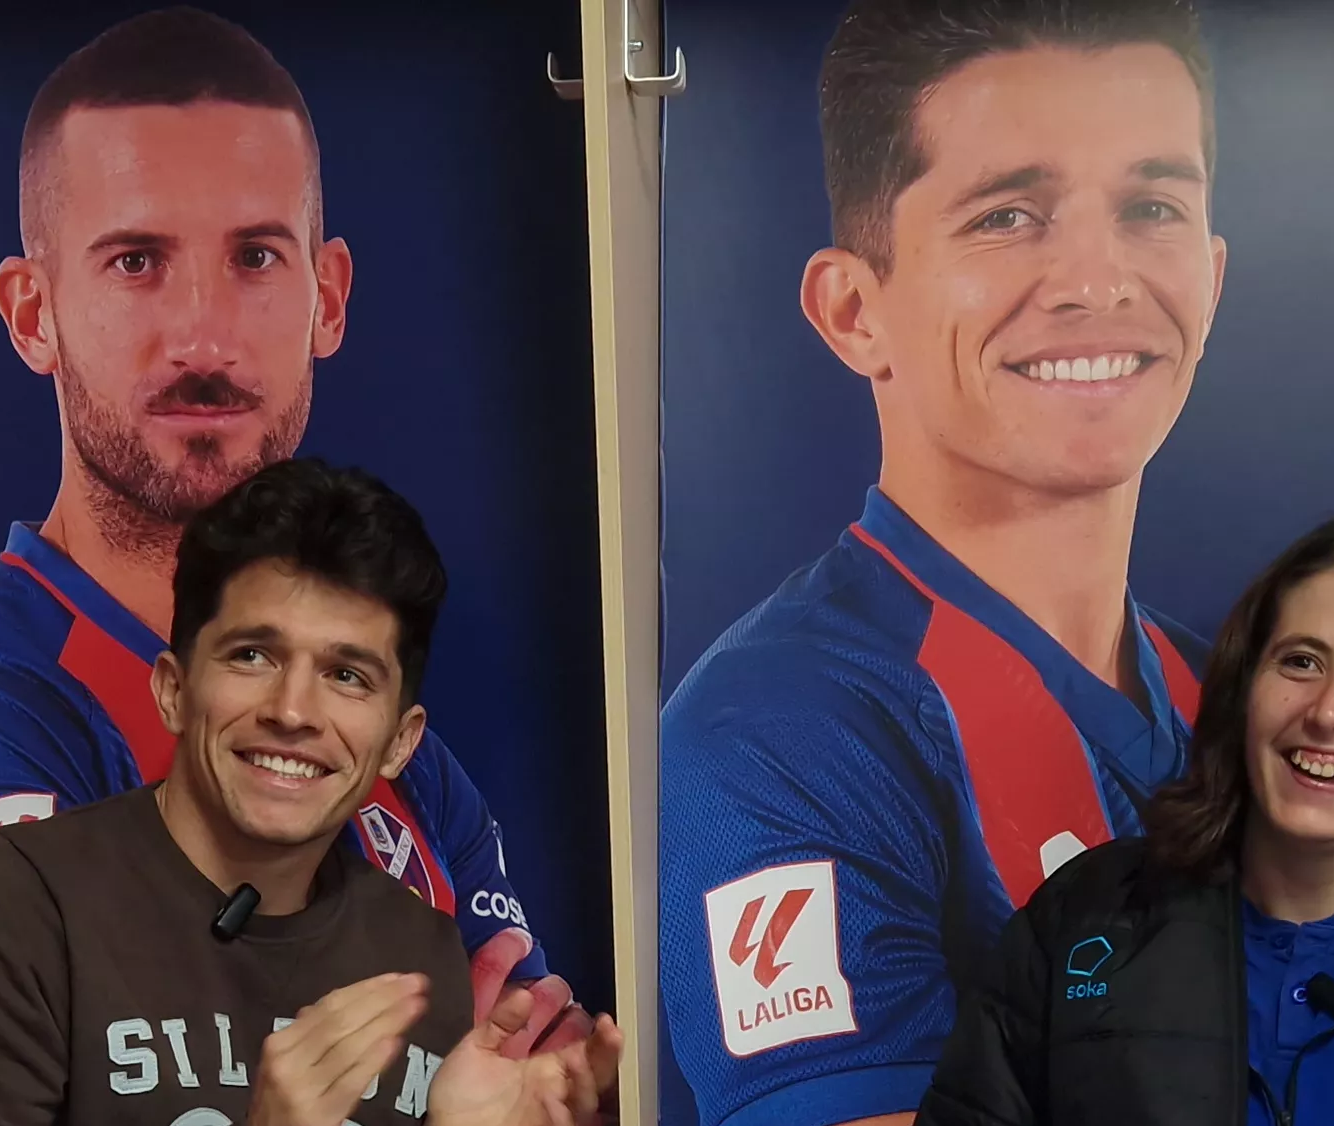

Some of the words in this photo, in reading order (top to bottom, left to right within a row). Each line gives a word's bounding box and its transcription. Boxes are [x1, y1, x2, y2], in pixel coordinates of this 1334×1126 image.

[738, 985, 833, 1031] LALIGA
[1067, 980, 1107, 999] soka
[107, 1012, 443, 1119] SILN
